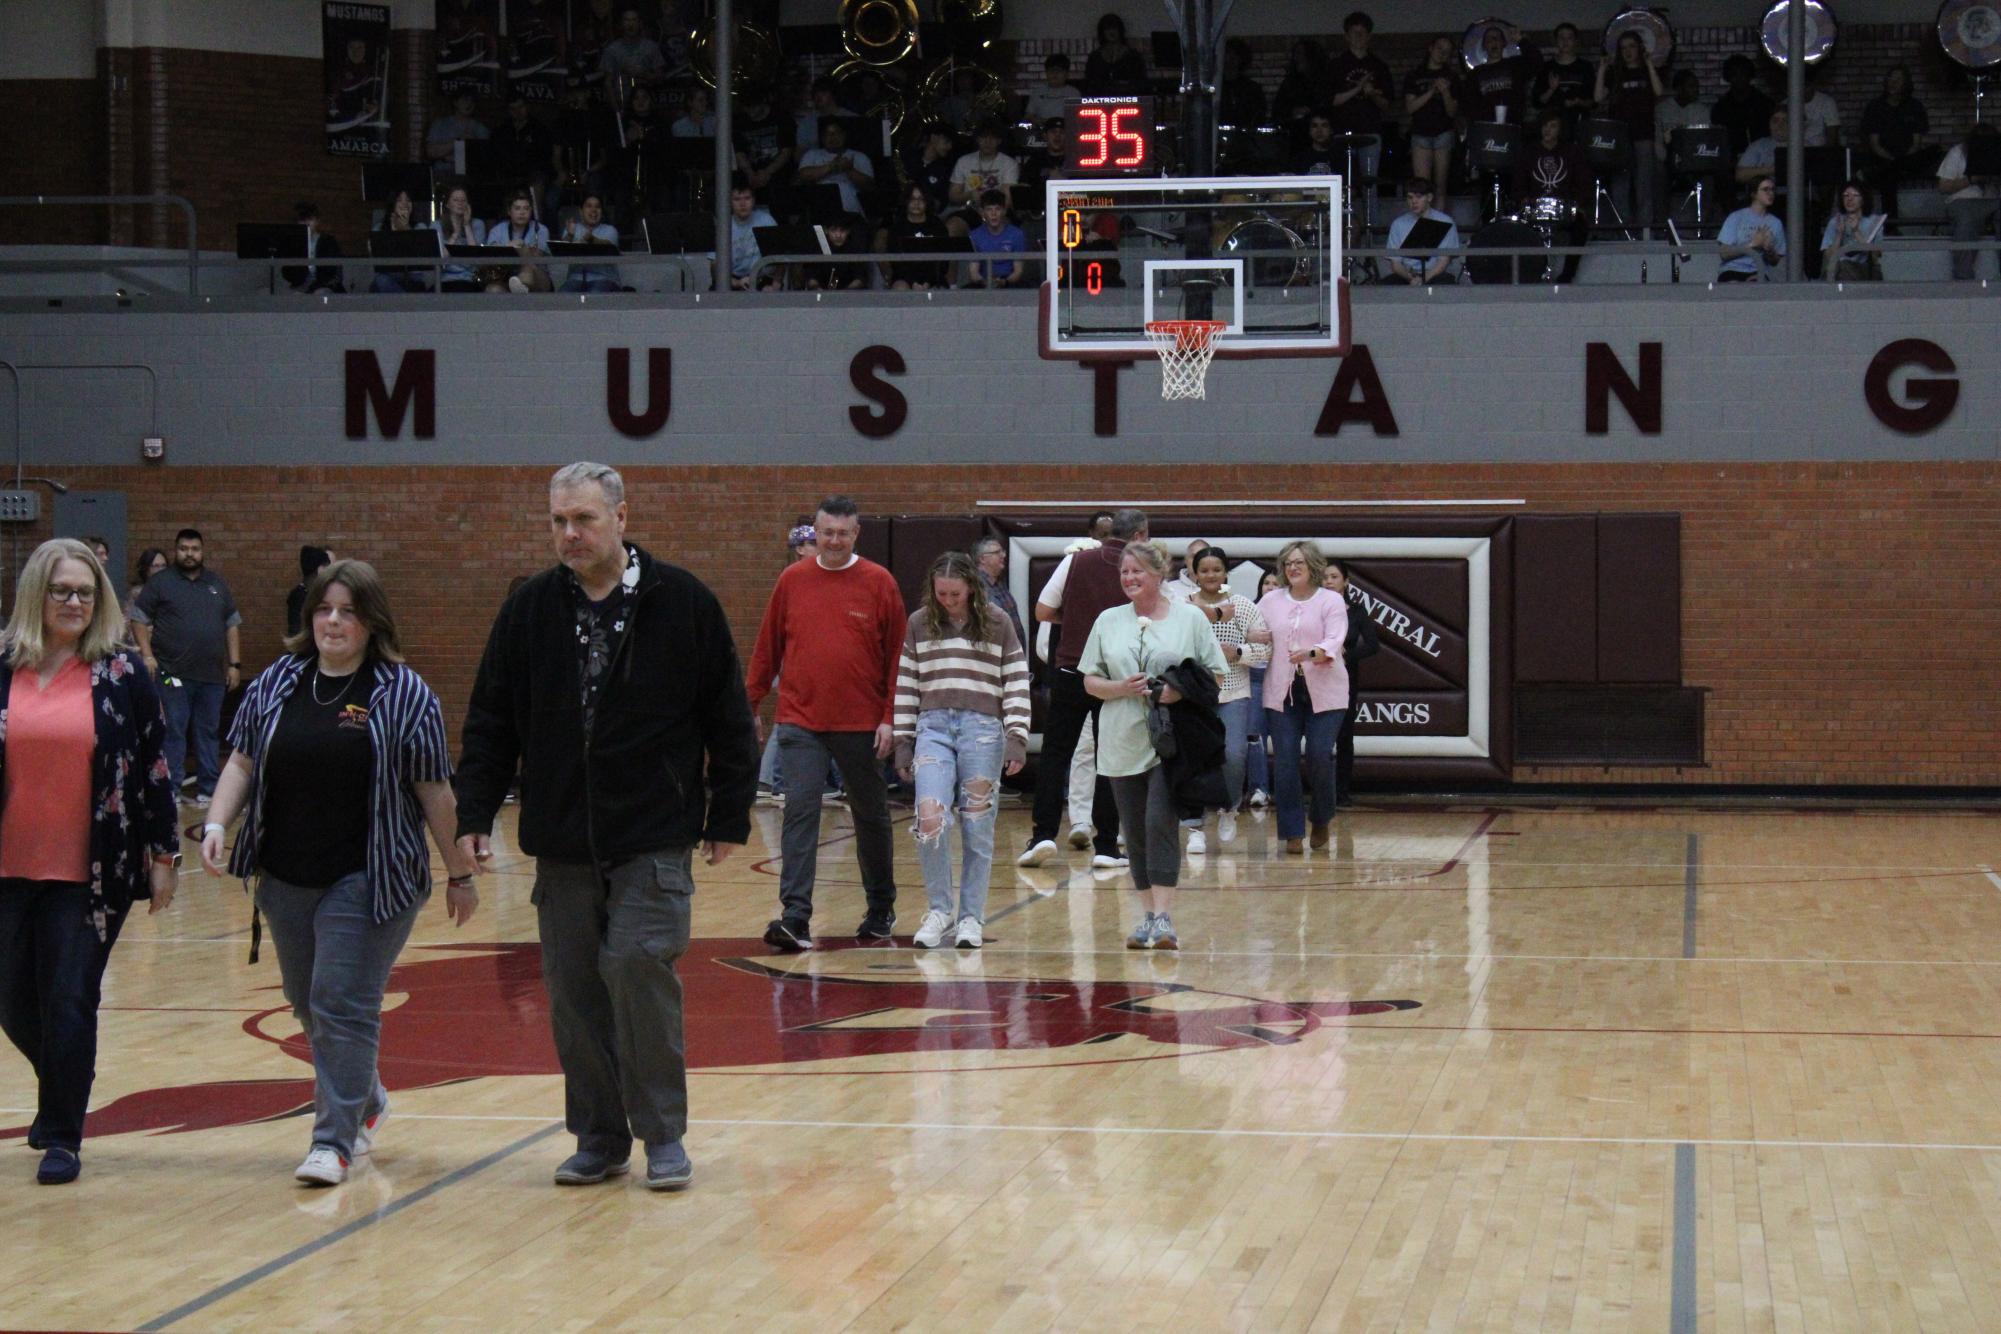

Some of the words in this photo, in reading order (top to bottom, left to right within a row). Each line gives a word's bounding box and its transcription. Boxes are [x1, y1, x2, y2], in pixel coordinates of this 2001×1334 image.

[327, 3, 386, 22] MUSTANGS
[328, 139, 391, 153] AMARCA
[1079, 109, 1142, 165] 35
[1087, 262, 1102, 295] 0
[1348, 583, 1441, 658] ENTRAL
[1355, 702, 1430, 724] ANGS
